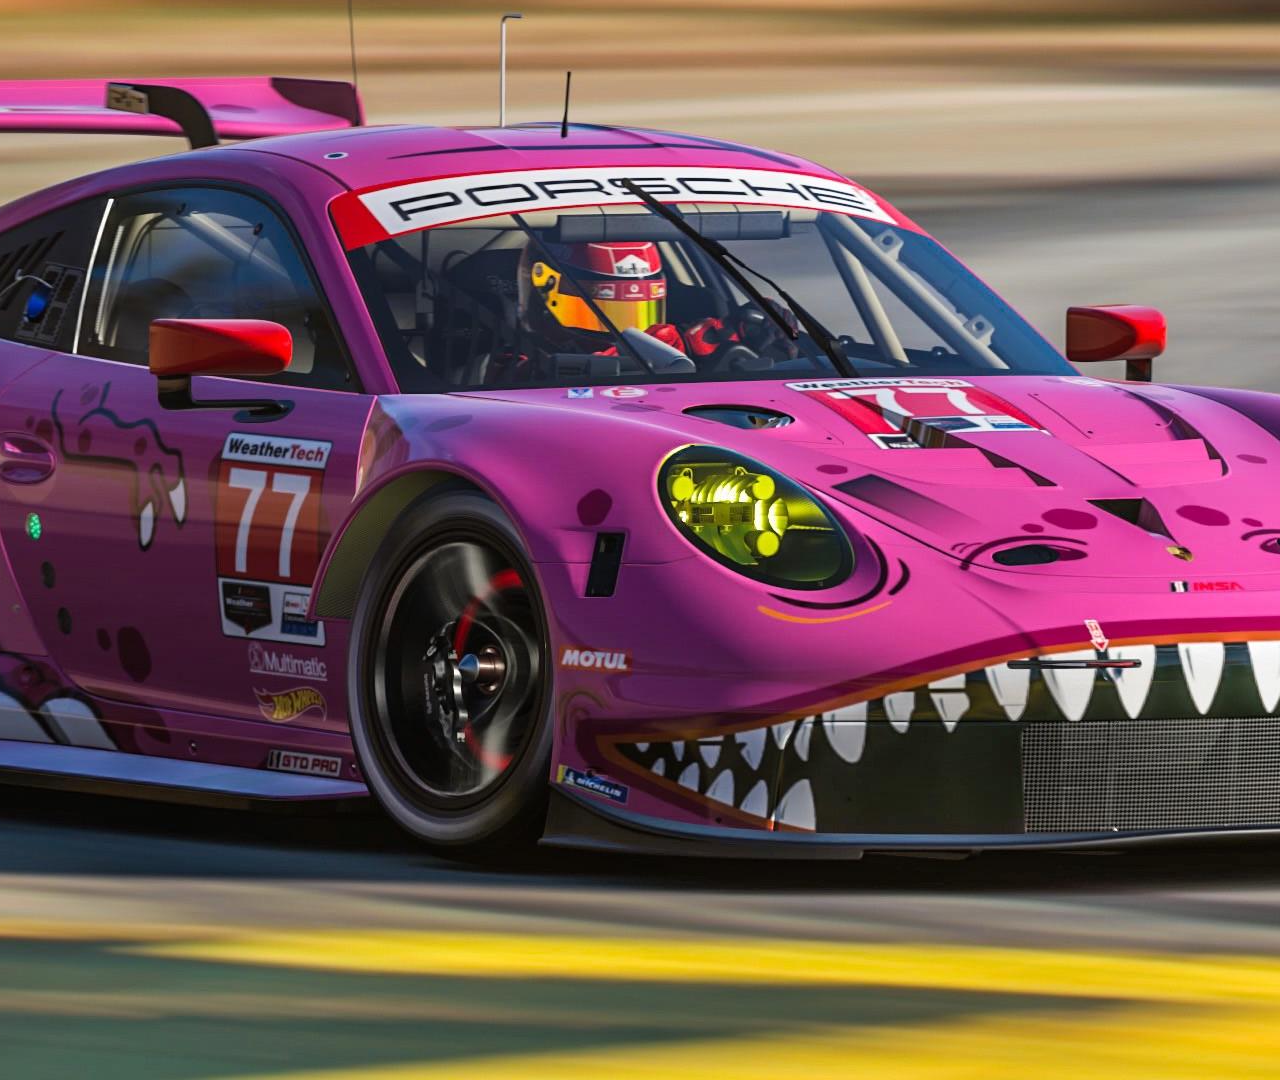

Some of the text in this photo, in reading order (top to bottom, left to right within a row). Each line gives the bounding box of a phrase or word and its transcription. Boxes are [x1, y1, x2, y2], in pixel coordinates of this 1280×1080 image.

[389, 176, 874, 222] PORSCHE
[794, 379, 963, 389] WeatherTech
[827, 387, 987, 431] 77
[228, 437, 324, 462] WeatherTech
[228, 467, 312, 578] 77
[263, 651, 328, 677] Multimatic
[561, 649, 627, 670] MOTUL
